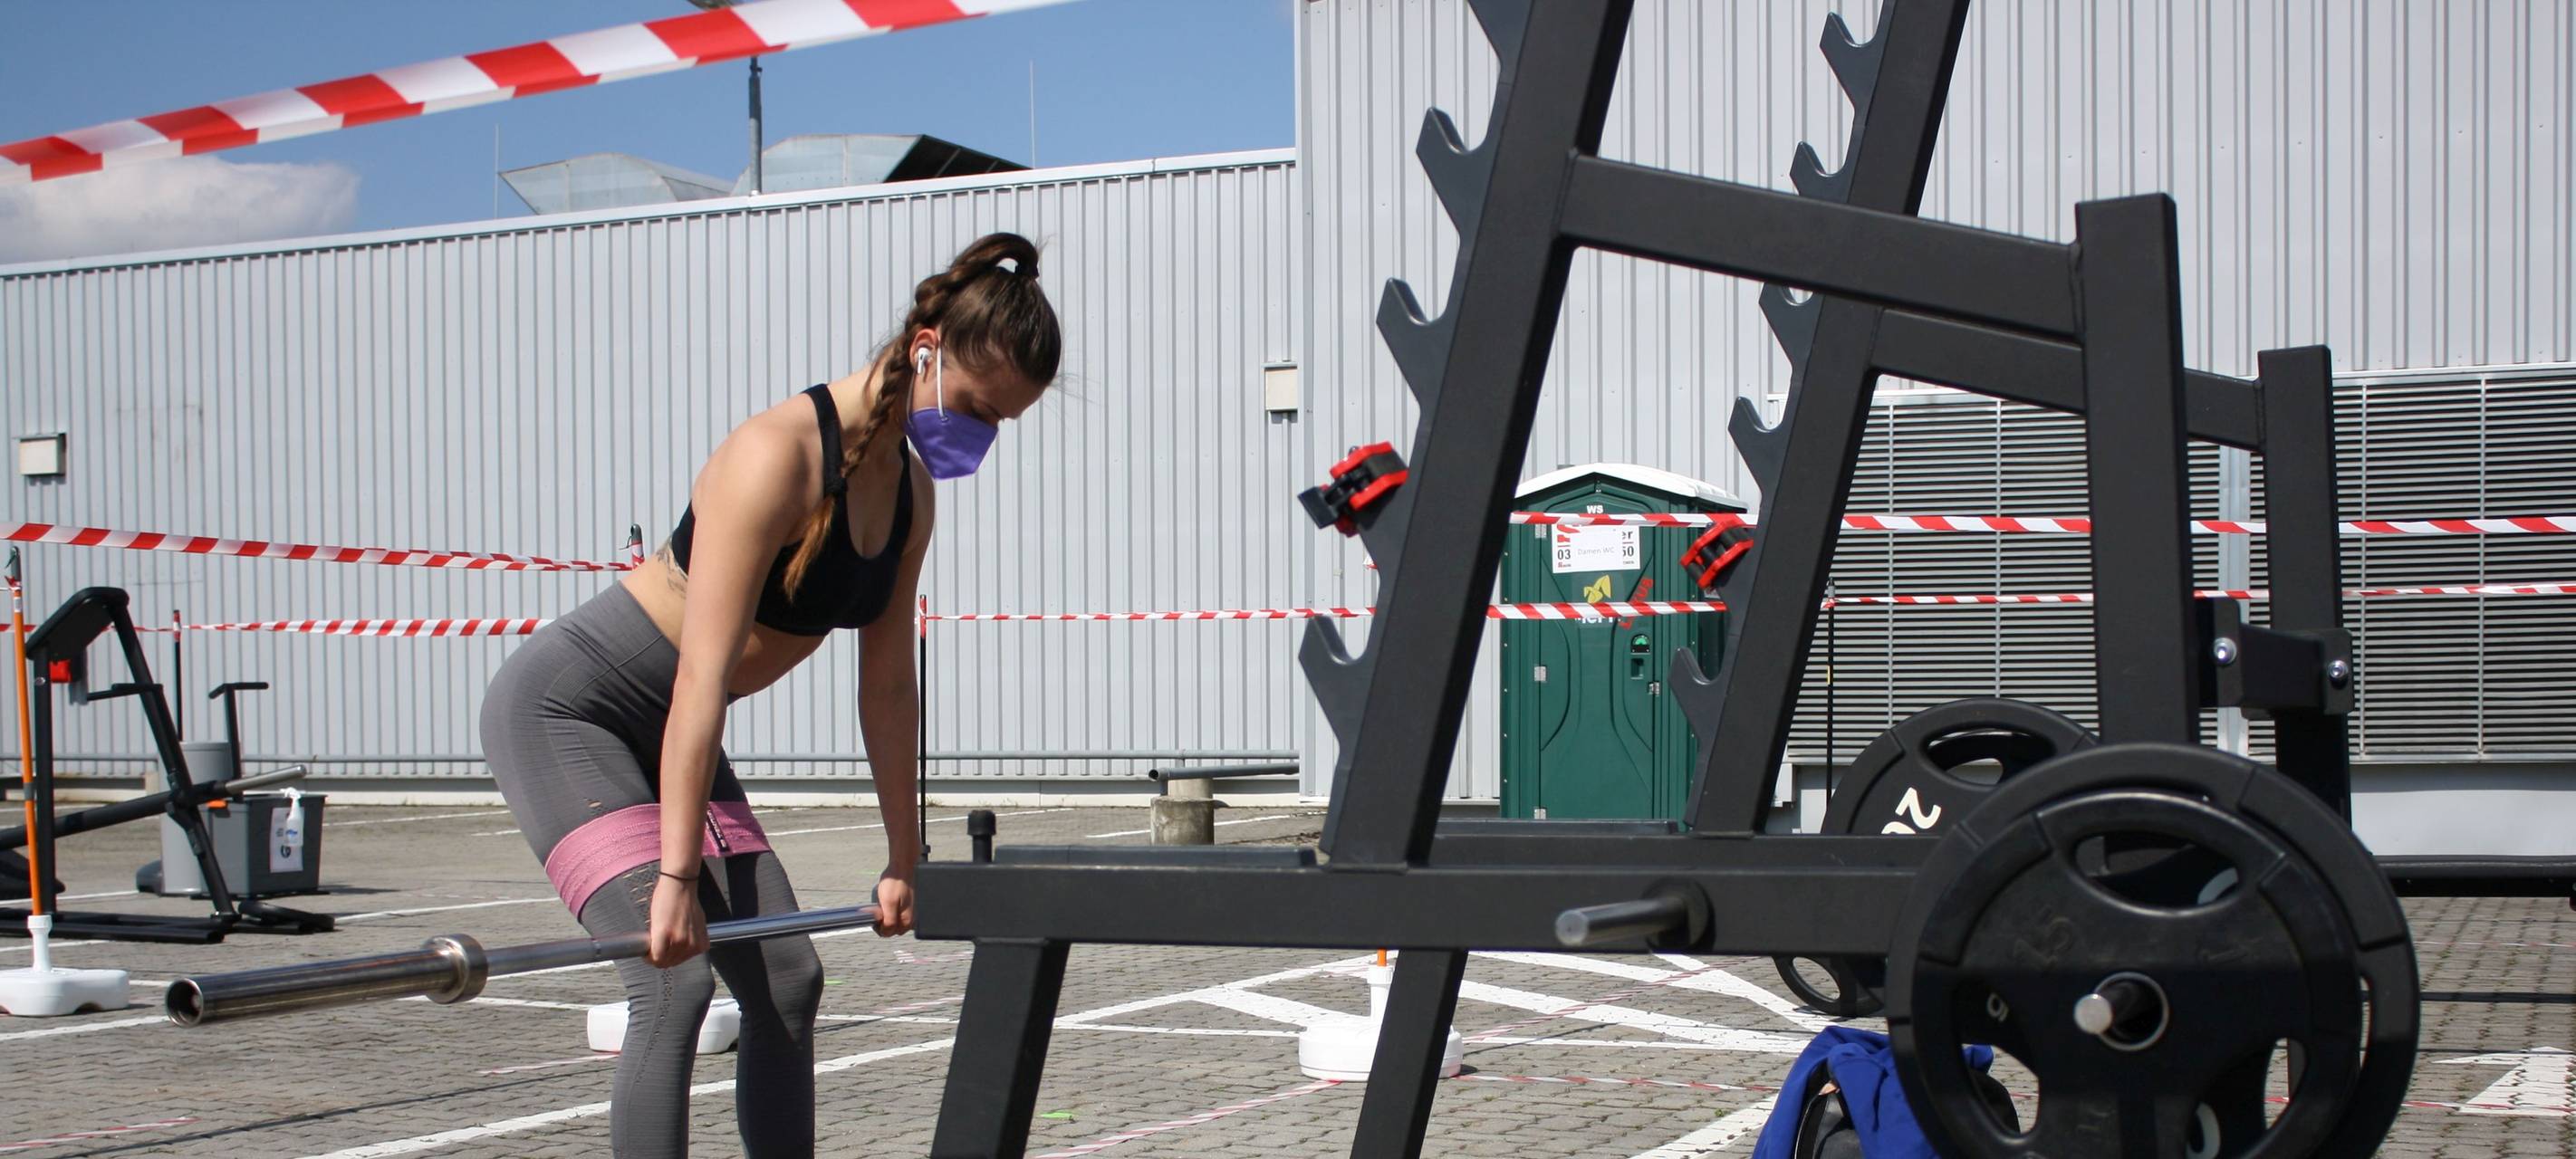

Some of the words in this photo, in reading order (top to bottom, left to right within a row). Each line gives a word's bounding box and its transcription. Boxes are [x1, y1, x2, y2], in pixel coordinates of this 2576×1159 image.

[1586, 504, 1604, 514] WS
[1557, 549, 1572, 560] 03
[1577, 548, 1601, 556] Damen
[1602, 546, 1615, 554] WC
